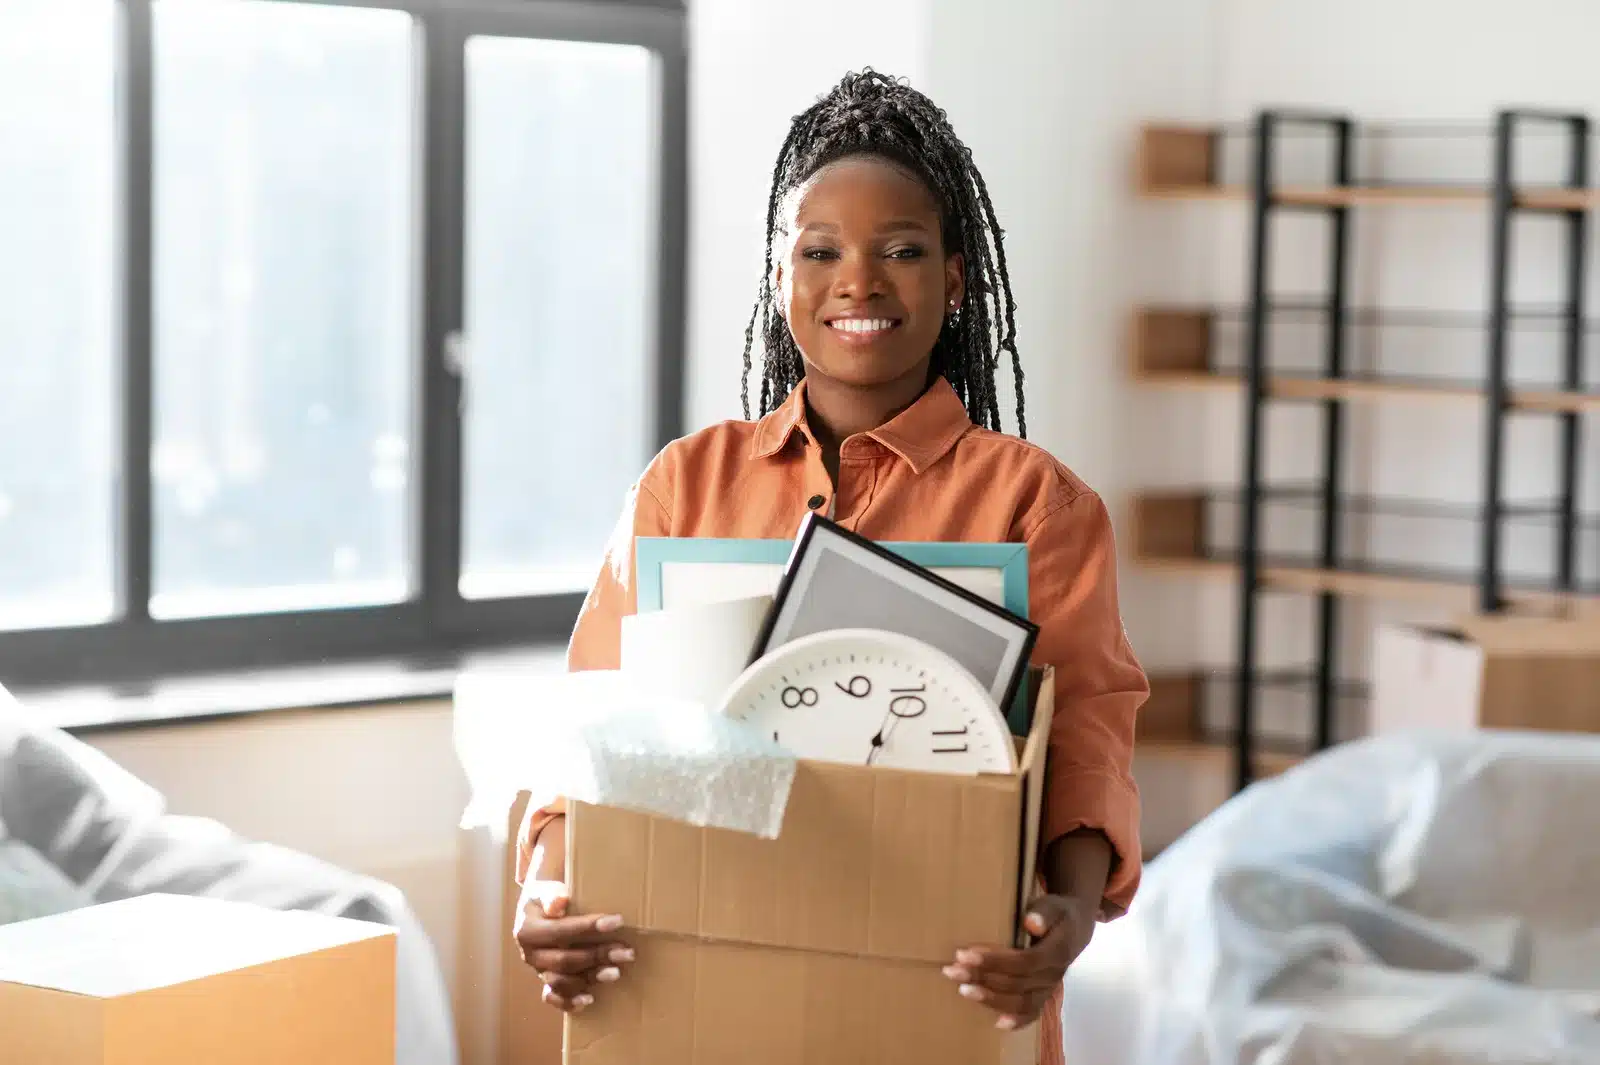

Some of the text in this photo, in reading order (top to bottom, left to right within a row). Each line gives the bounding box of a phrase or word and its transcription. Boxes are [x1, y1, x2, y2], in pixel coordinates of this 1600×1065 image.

[781, 686, 818, 708] 8
[835, 675, 872, 698] 9
[890, 684, 926, 718] 10
[932, 726, 968, 753] 11
